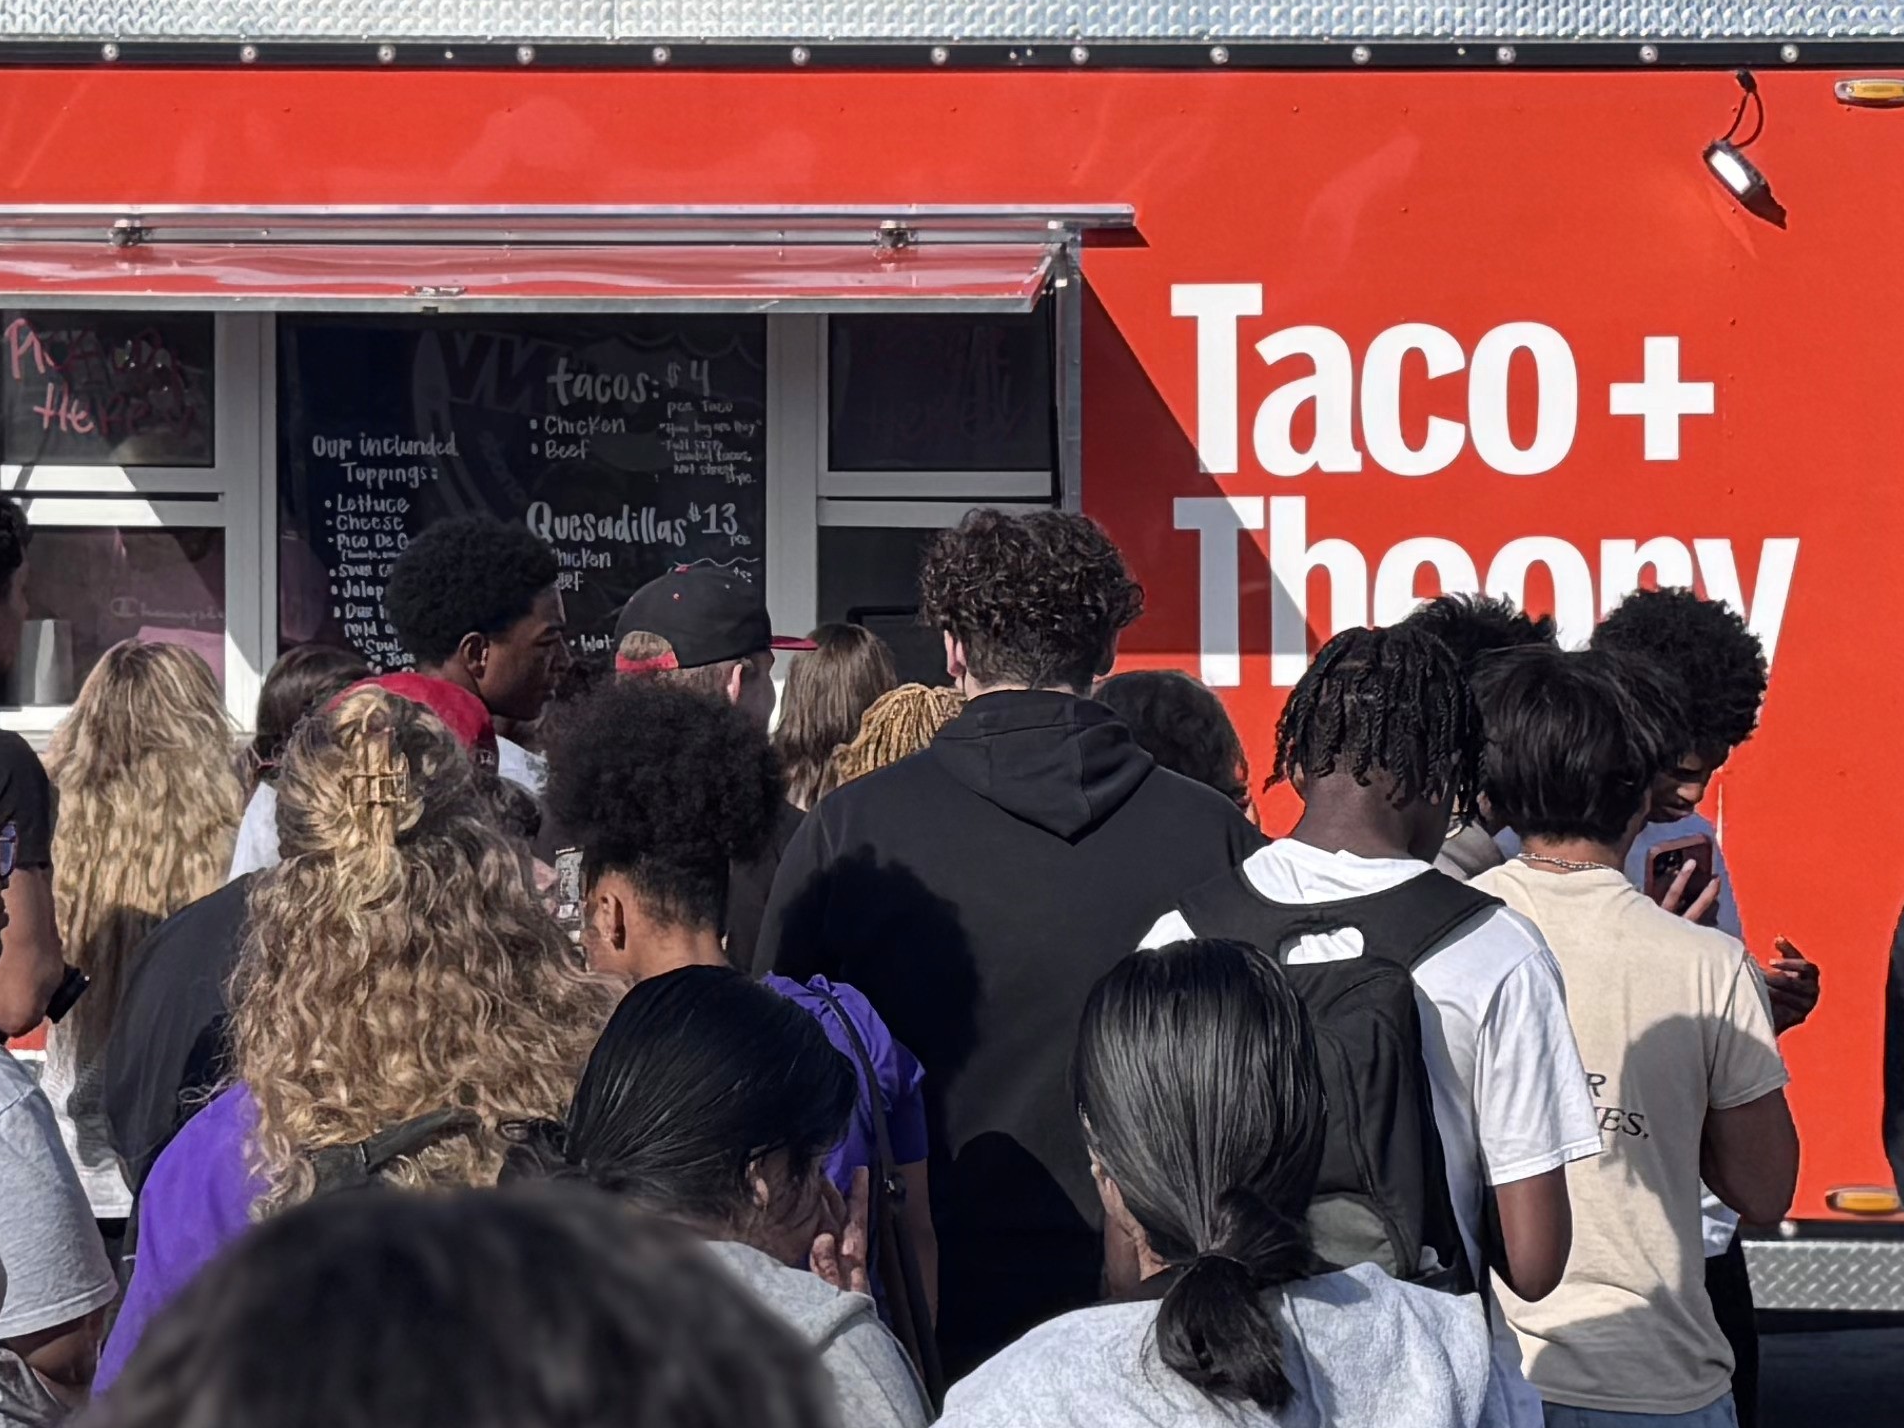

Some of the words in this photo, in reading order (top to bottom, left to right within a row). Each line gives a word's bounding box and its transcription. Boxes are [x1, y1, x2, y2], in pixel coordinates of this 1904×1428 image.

[547, 357, 660, 406] tacos:
[1171, 283, 1578, 476] Taco
[545, 416, 626, 435] Chicken
[312, 434, 353, 460] Our
[545, 439, 591, 460] Beef
[339, 462, 439, 490] Toppings:
[336, 493, 411, 514] Lettuce
[335, 514, 405, 531] Cheese
[526, 502, 687, 547] Quesadillas
[551, 547, 611, 569] hicken
[1594, 1106, 1650, 1140] ES.
